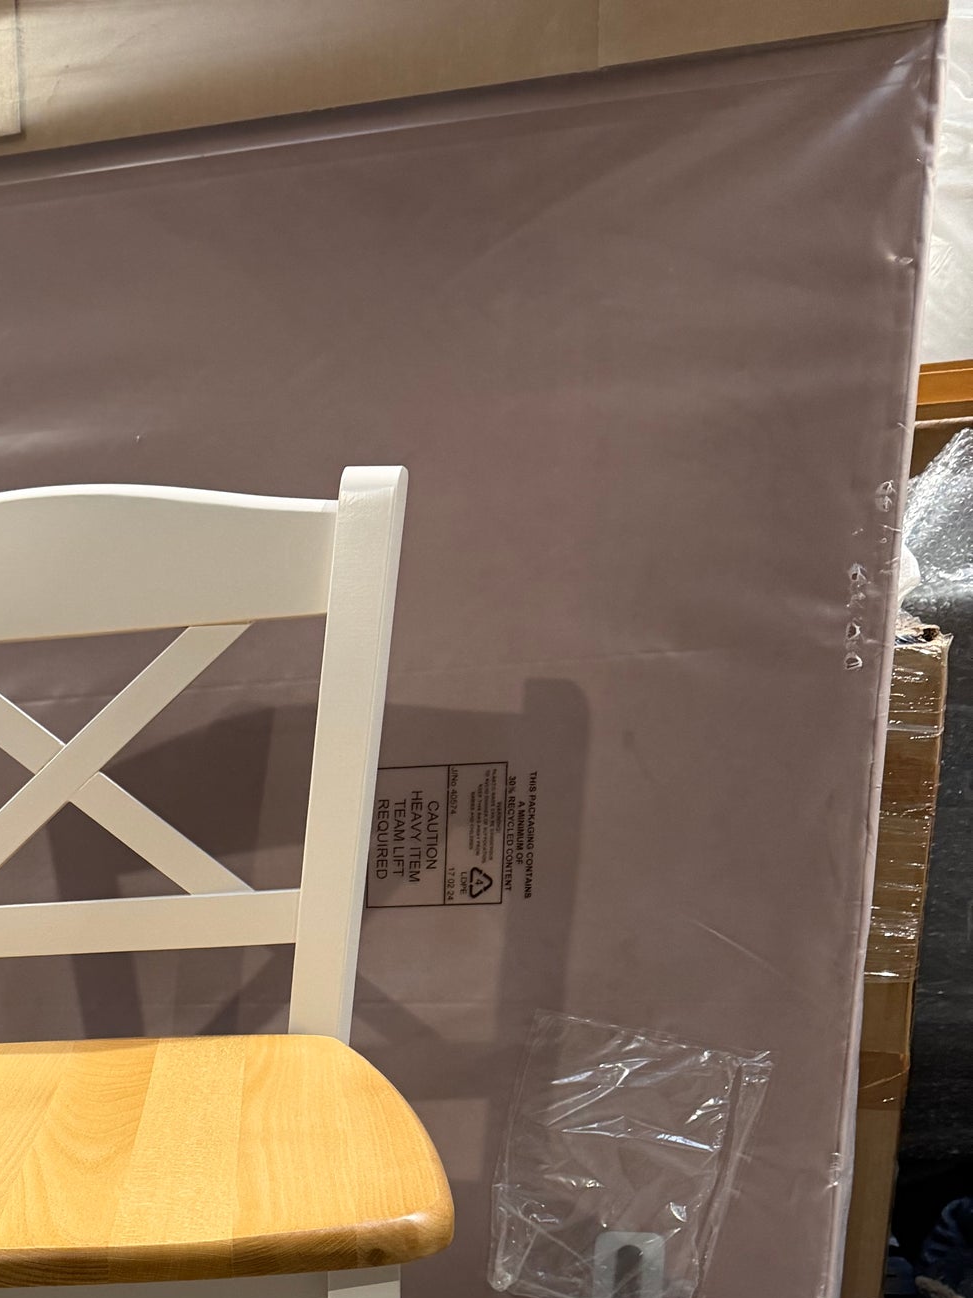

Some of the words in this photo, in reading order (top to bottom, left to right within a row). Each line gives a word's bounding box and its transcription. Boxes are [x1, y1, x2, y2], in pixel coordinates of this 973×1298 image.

[508, 776, 516, 793] 30%
[529, 772, 537, 792] THIS
[394, 799, 406, 841] TEAM
[410, 791, 423, 842] HEAVY
[426, 801, 440, 869] CAUTION
[507, 796, 515, 846] RECYCLED
[516, 810, 525, 850] MINIMUM
[526, 795, 536, 850] PACKAGING
[377, 800, 390, 879] REQUIRED
[516, 853, 523, 865] OF
[393, 847, 405, 876] LIFT
[409, 847, 421, 882] ITEM
[448, 867, 455, 876] 17
[505, 849, 513, 891] CONTENT
[524, 852, 533, 899] CONTAINS
[447, 879, 455, 888] 02
[447, 891, 454, 900] 24
